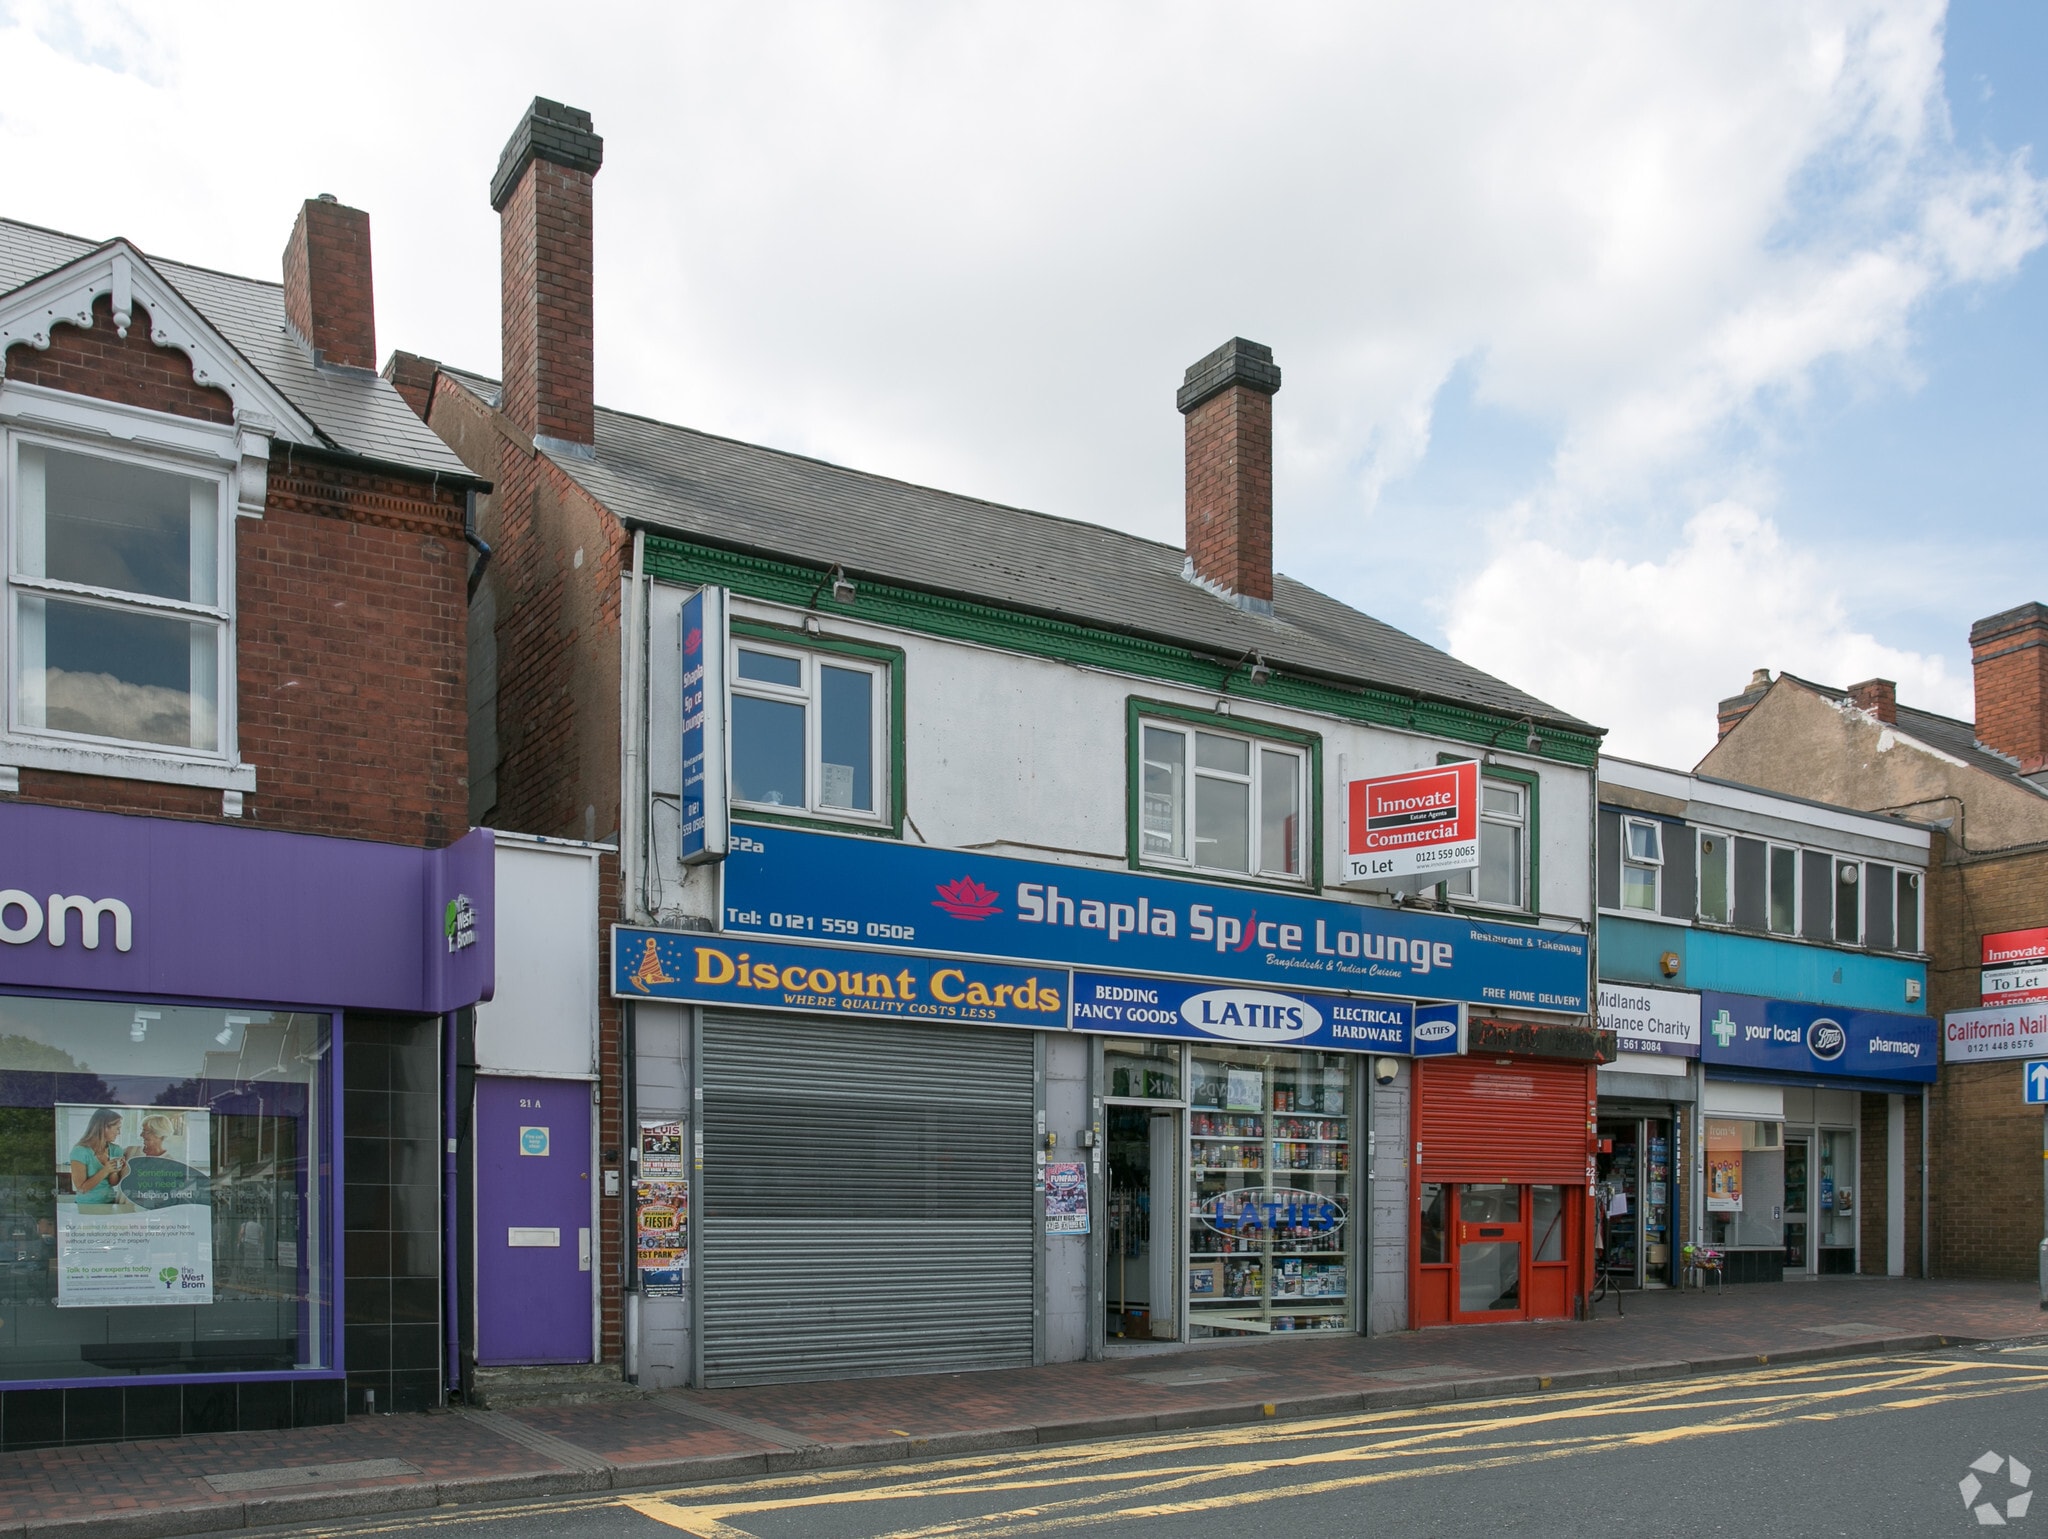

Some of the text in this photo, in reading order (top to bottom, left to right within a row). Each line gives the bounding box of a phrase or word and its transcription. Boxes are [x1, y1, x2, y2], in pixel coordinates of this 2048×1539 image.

[684, 664, 704, 688] Shapla
[683, 710, 704, 733] Lounge
[688, 802, 699, 816] 0121
[1377, 792, 1451, 813] Innovate
[683, 816, 704, 836] 559 0502
[1366, 822, 1458, 847] Commercial
[730, 836, 764, 854] 22a
[1416, 846, 1475, 862] 0121 559 0065
[1351, 860, 1393, 875] To Let
[727, 908, 914, 940] Tel: 0121 559 0502
[1017, 882, 1452, 974] Shapla Spice Lounge
[1470, 930, 1582, 956] Restaurant & Takeaway
[1989, 946, 2046, 960] Innovate
[1266, 954, 1402, 978] Bangladeshi & Indian Cuisine
[1984, 966, 2047, 978] Commercial Premises
[694, 948, 1061, 1012] Discount Cards
[1992, 976, 2038, 990] To Let
[1096, 985, 1158, 1004] BEDDING
[1482, 987, 1581, 1006] FREE HOME DELIVERY
[784, 993, 997, 1020] WHERE QUALITY COSTS LESS
[1074, 1003, 1178, 1025] FANCY GOODS
[1202, 1000, 1304, 1031] LATIFS
[1333, 1006, 1403, 1025] ELECTRICAL
[1332, 1024, 1402, 1042] HARDWARE
[1420, 1026, 1450, 1036] LATIFS
[1648, 1018, 1690, 1040] Charity
[1947, 1018, 2014, 1041] California
[1624, 1039, 1638, 1050] 561
[1642, 1041, 1661, 1052] 3084
[1746, 1024, 1920, 1058] your local Boots pharmacy
[1968, 1040, 2034, 1053] 0121 448 6576
[520, 1098, 541, 1108] 21 A
[644, 1126, 680, 1134] ELVIS
[1710, 1126, 1727, 1136] from
[138, 1169, 184, 1177] Sometimes
[1050, 1174, 1078, 1182] FUNFAIR
[1586, 1168, 1596, 1176] 22
[1590, 1176, 1596, 1184] A
[138, 1182, 152, 1190] you
[138, 1190, 168, 1200] helping
[644, 1216, 673, 1228] FIESTA
[1216, 1202, 1335, 1231] LATIFS
[105, 1266, 130, 1274] experts
[182, 1266, 194, 1274] the
[182, 1281, 206, 1289] Brom
